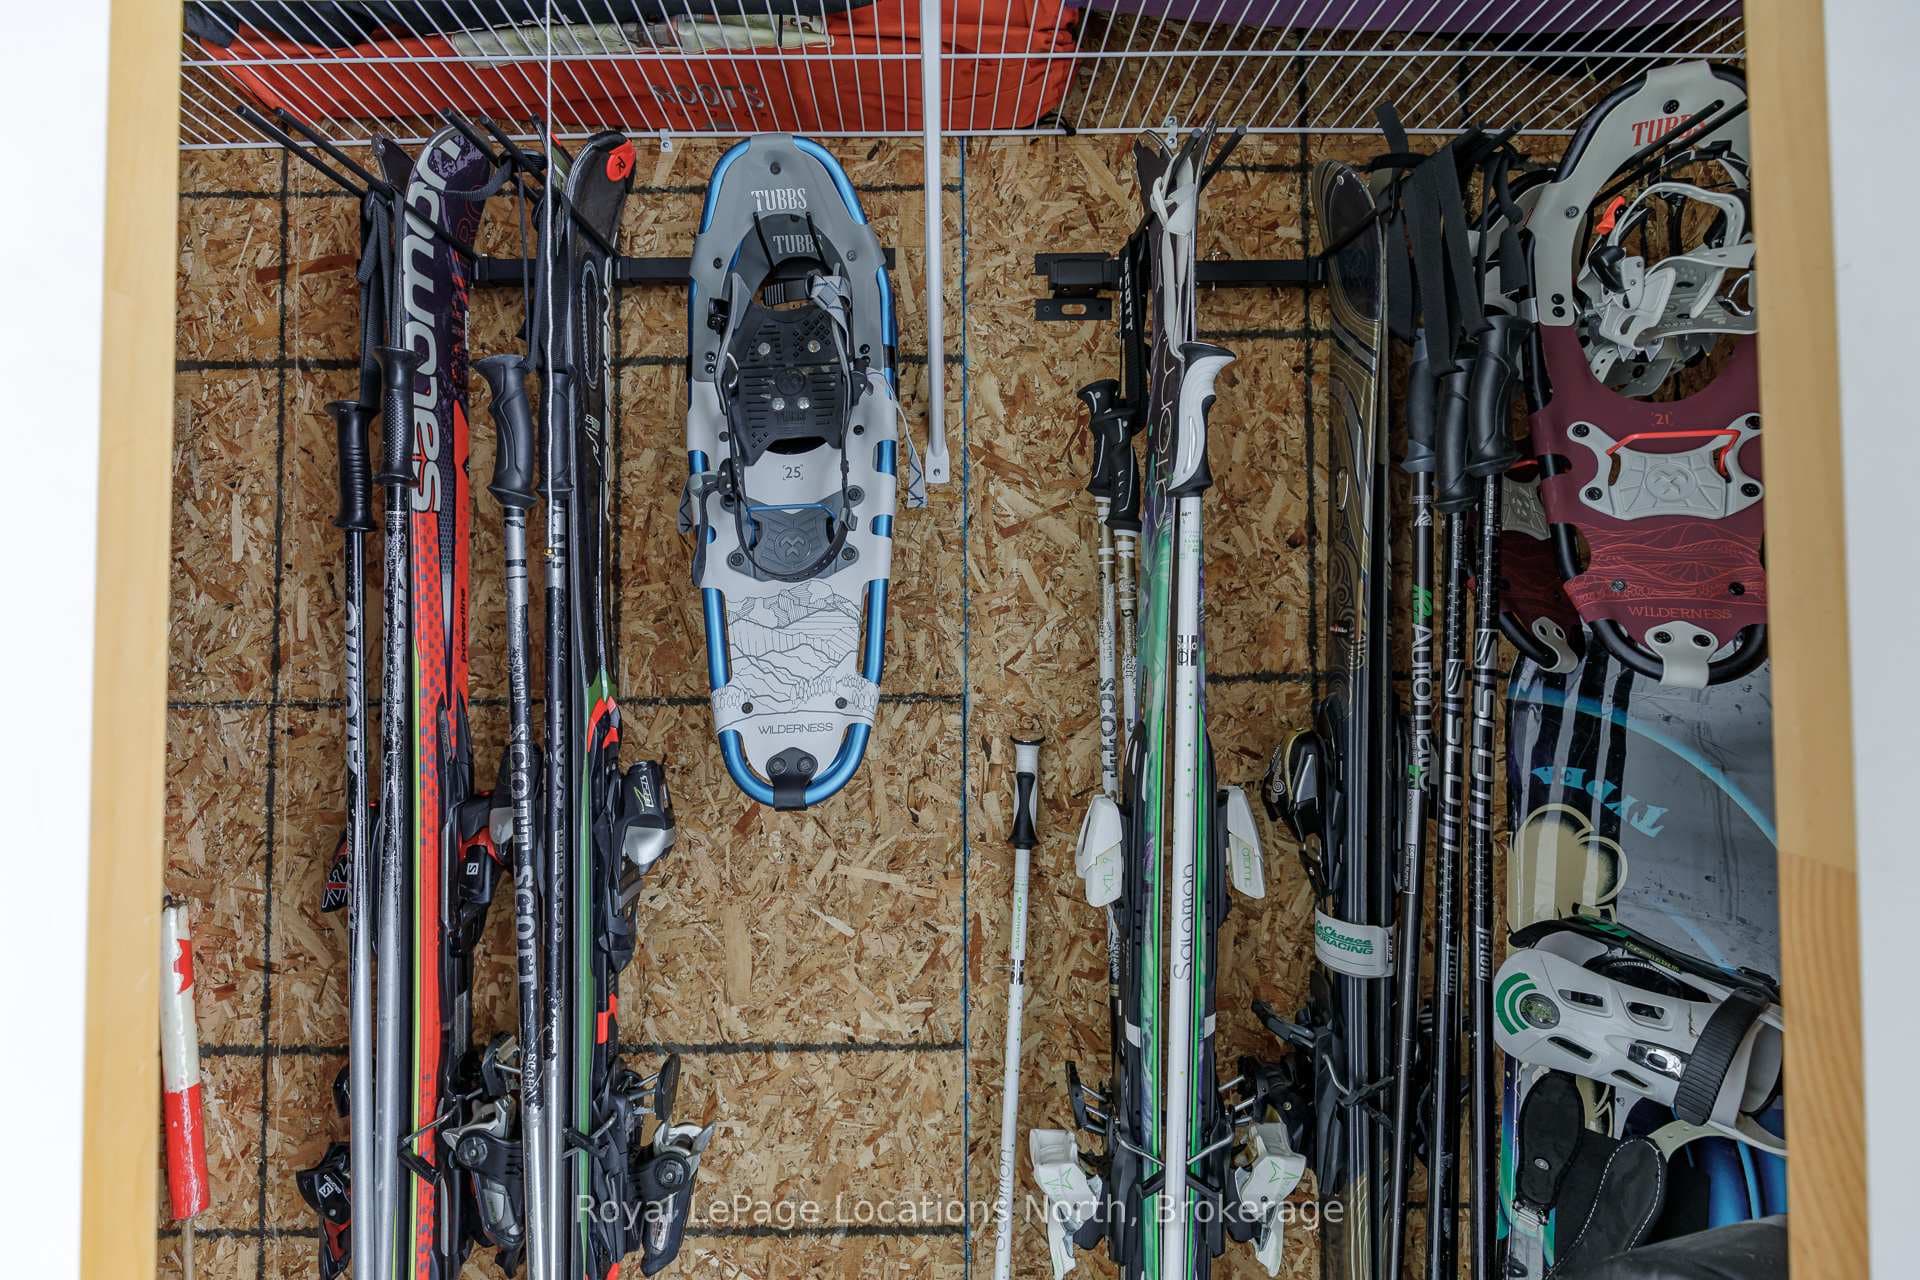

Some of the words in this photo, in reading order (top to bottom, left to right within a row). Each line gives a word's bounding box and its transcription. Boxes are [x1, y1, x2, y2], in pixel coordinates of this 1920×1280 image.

[751, 187, 808, 212] TUBBS
[773, 234, 824, 255] TUBBS
[1124, 256, 1134, 331] SCOTT
[1653, 411, 1672, 425] 21
[459, 588, 467, 663] powerline
[1626, 605, 1732, 620] WILDERNESS
[345, 601, 359, 775] ATOMIC
[758, 722, 833, 734] WILDERNESS
[1099, 677, 1117, 778] SCOTT
[1471, 685, 1494, 833] SCOTT
[509, 723, 533, 851] SCOTT
[513, 865, 537, 991] SCOTT
[1173, 863, 1192, 982] Salomon
